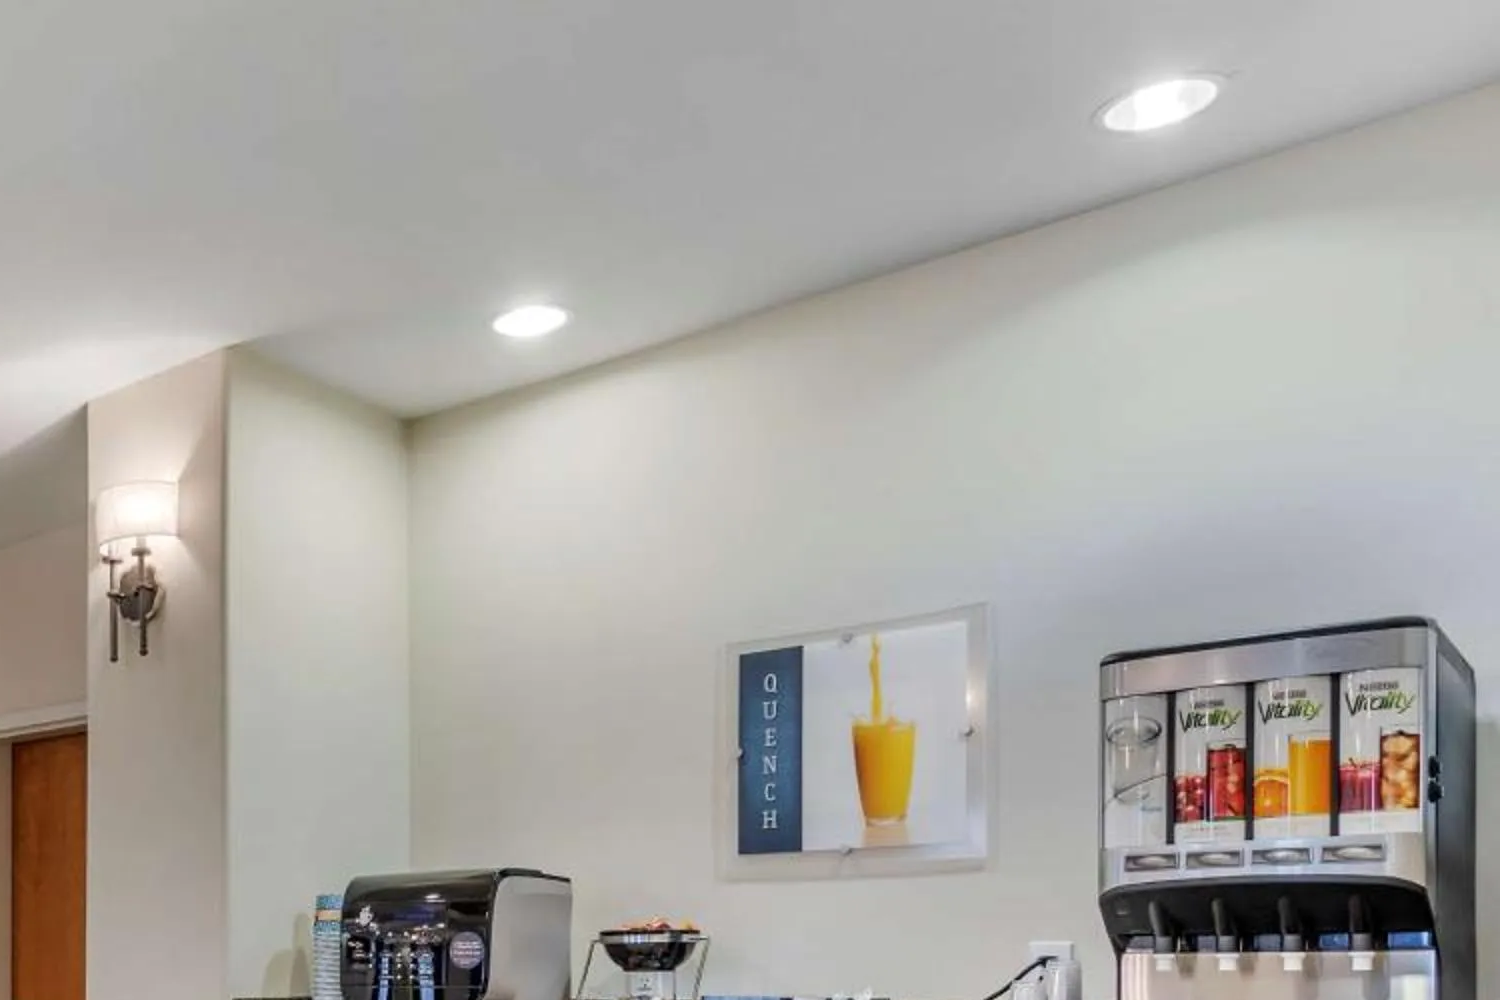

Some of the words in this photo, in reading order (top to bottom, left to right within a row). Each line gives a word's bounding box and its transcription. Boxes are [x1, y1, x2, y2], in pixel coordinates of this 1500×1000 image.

[1257, 698, 1323, 725] Vitality
[1345, 690, 1414, 716] Vitality
[1179, 709, 1242, 732] Vitality
[762, 673, 778, 829] QUENCH
